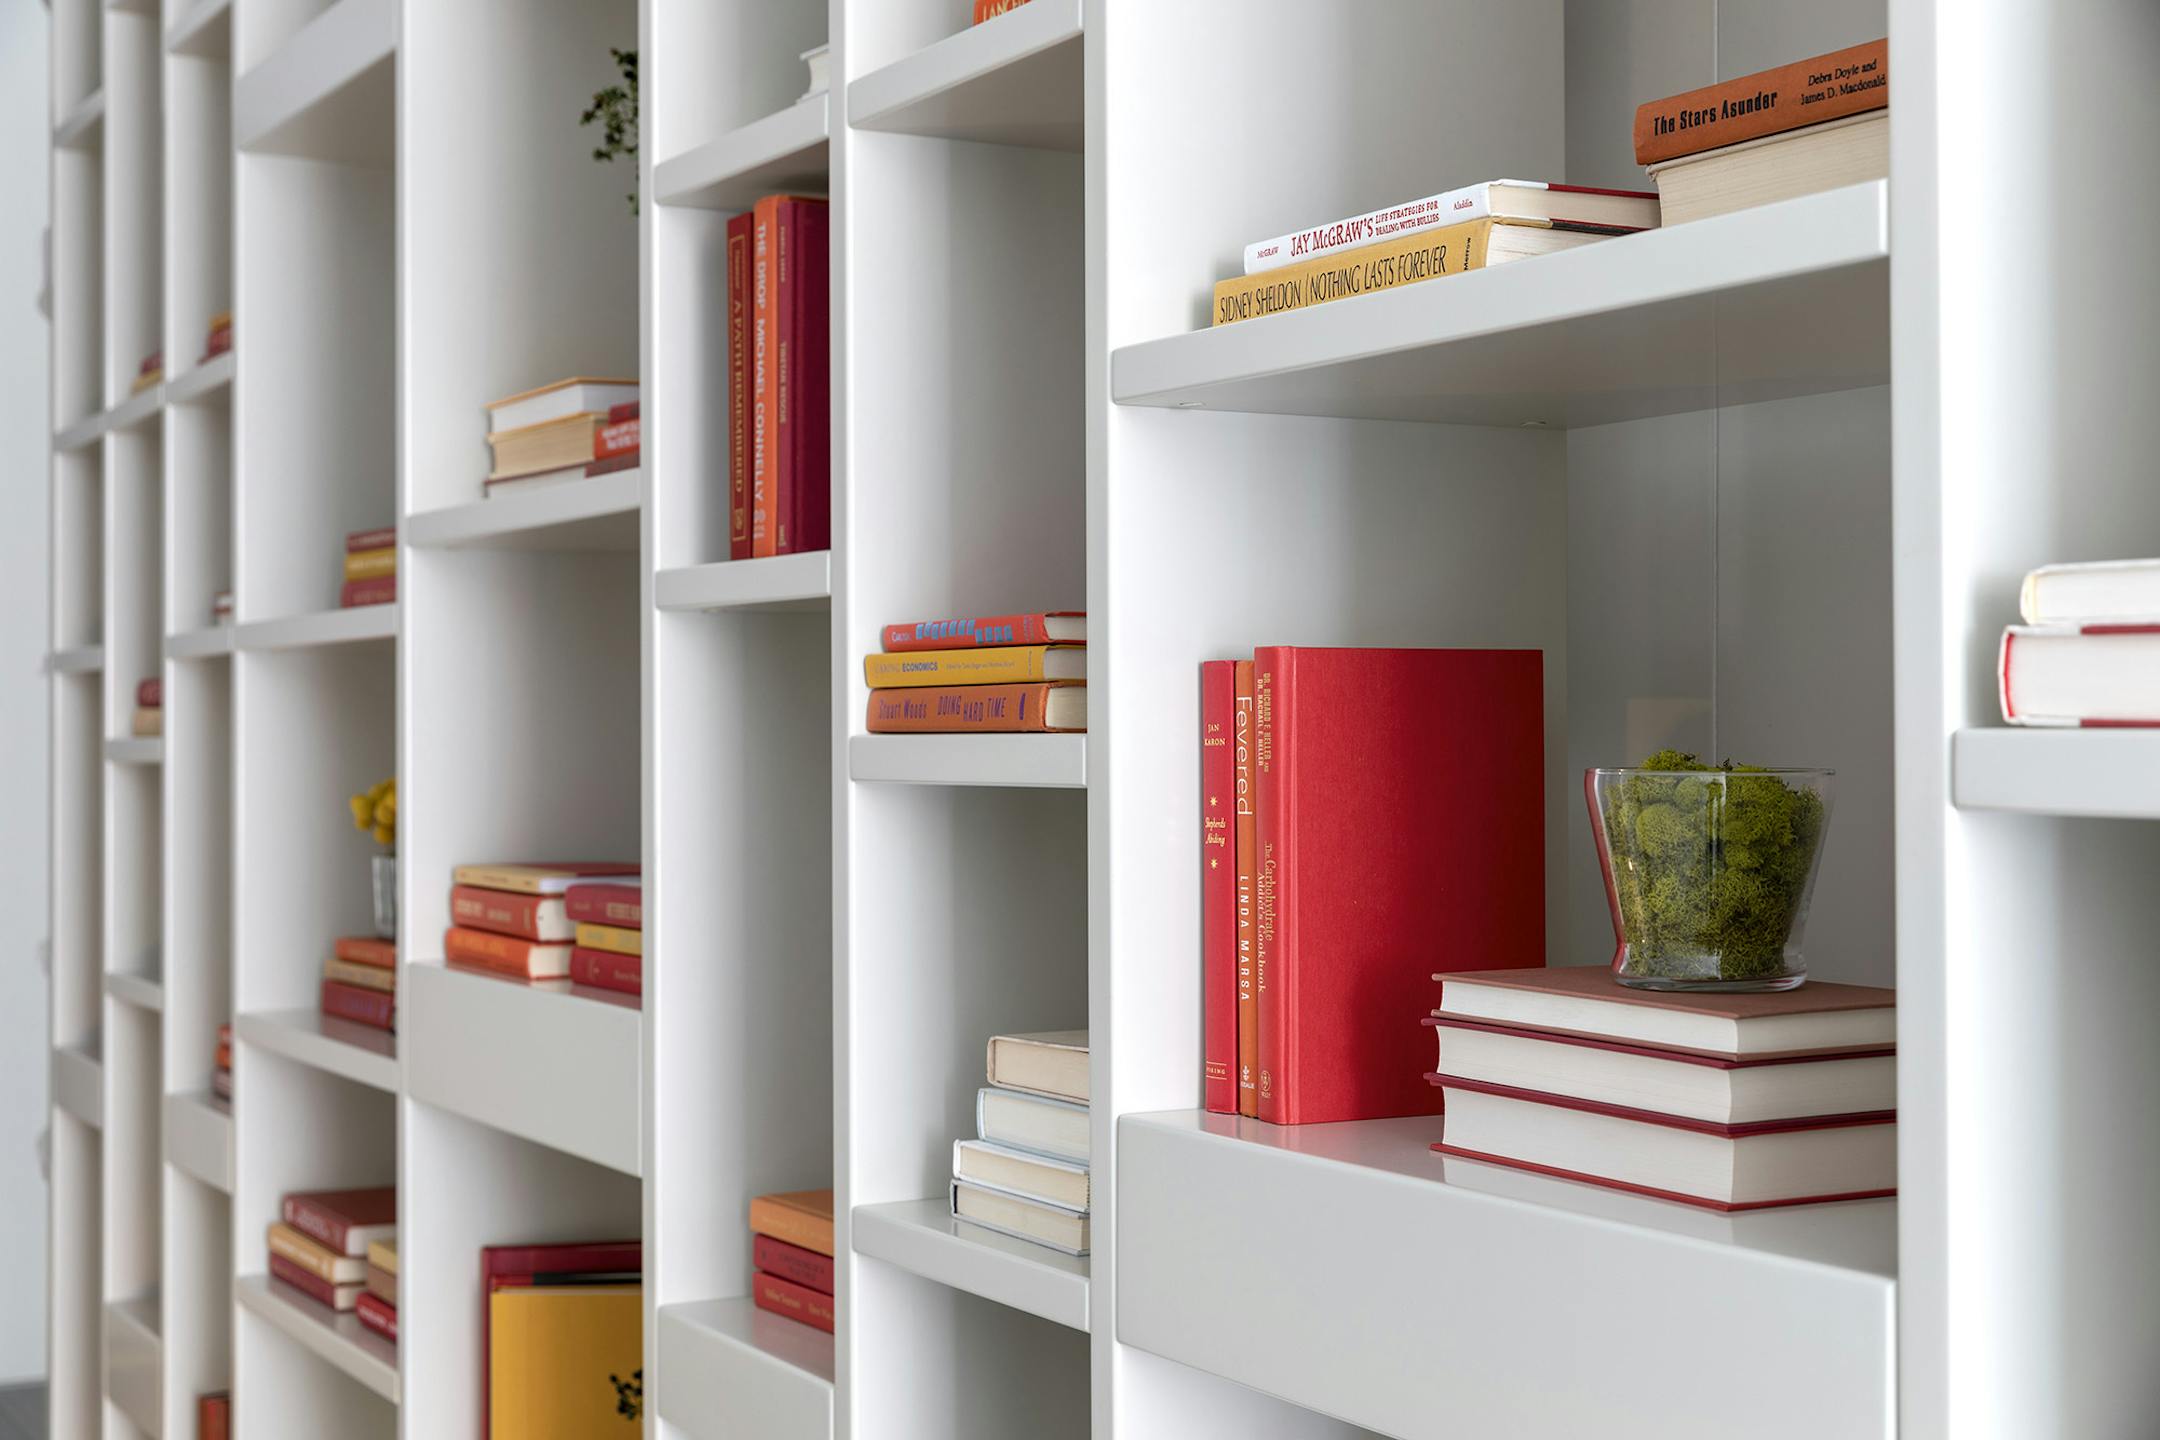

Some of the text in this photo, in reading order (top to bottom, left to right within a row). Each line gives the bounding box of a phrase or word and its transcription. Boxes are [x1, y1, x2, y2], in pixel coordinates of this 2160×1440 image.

[1800, 73, 1886, 106] James D. Macdonald
[1808, 59, 1878, 86] Debra Doyle and
[1654, 91, 1778, 136] The Stars Asunder
[1374, 200, 1438, 224] LIFE STRATEGIES FOR
[1453, 199, 1473, 211] Aladdin
[1290, 218, 1374, 256] JAY McGRAW'S
[1376, 213, 1440, 236] DEALING WITH BULLIES
[1310, 245, 1447, 302] NOTHING LASTS FOREVER
[1220, 280, 1302, 324] SIDNEY SHELDON
[755, 402, 766, 502] CONNELLY
[1263, 673, 1271, 686] DR.
[1263, 688, 1271, 722] RICHARD
[1236, 696, 1254, 816] Fevered
[1263, 733, 1271, 760] HELLER
[1265, 860, 1277, 942] Carbohydrate
[1240, 875, 1250, 1000] LINDA MARSA
[1257, 872, 1266, 994] Addict's Cookbook
